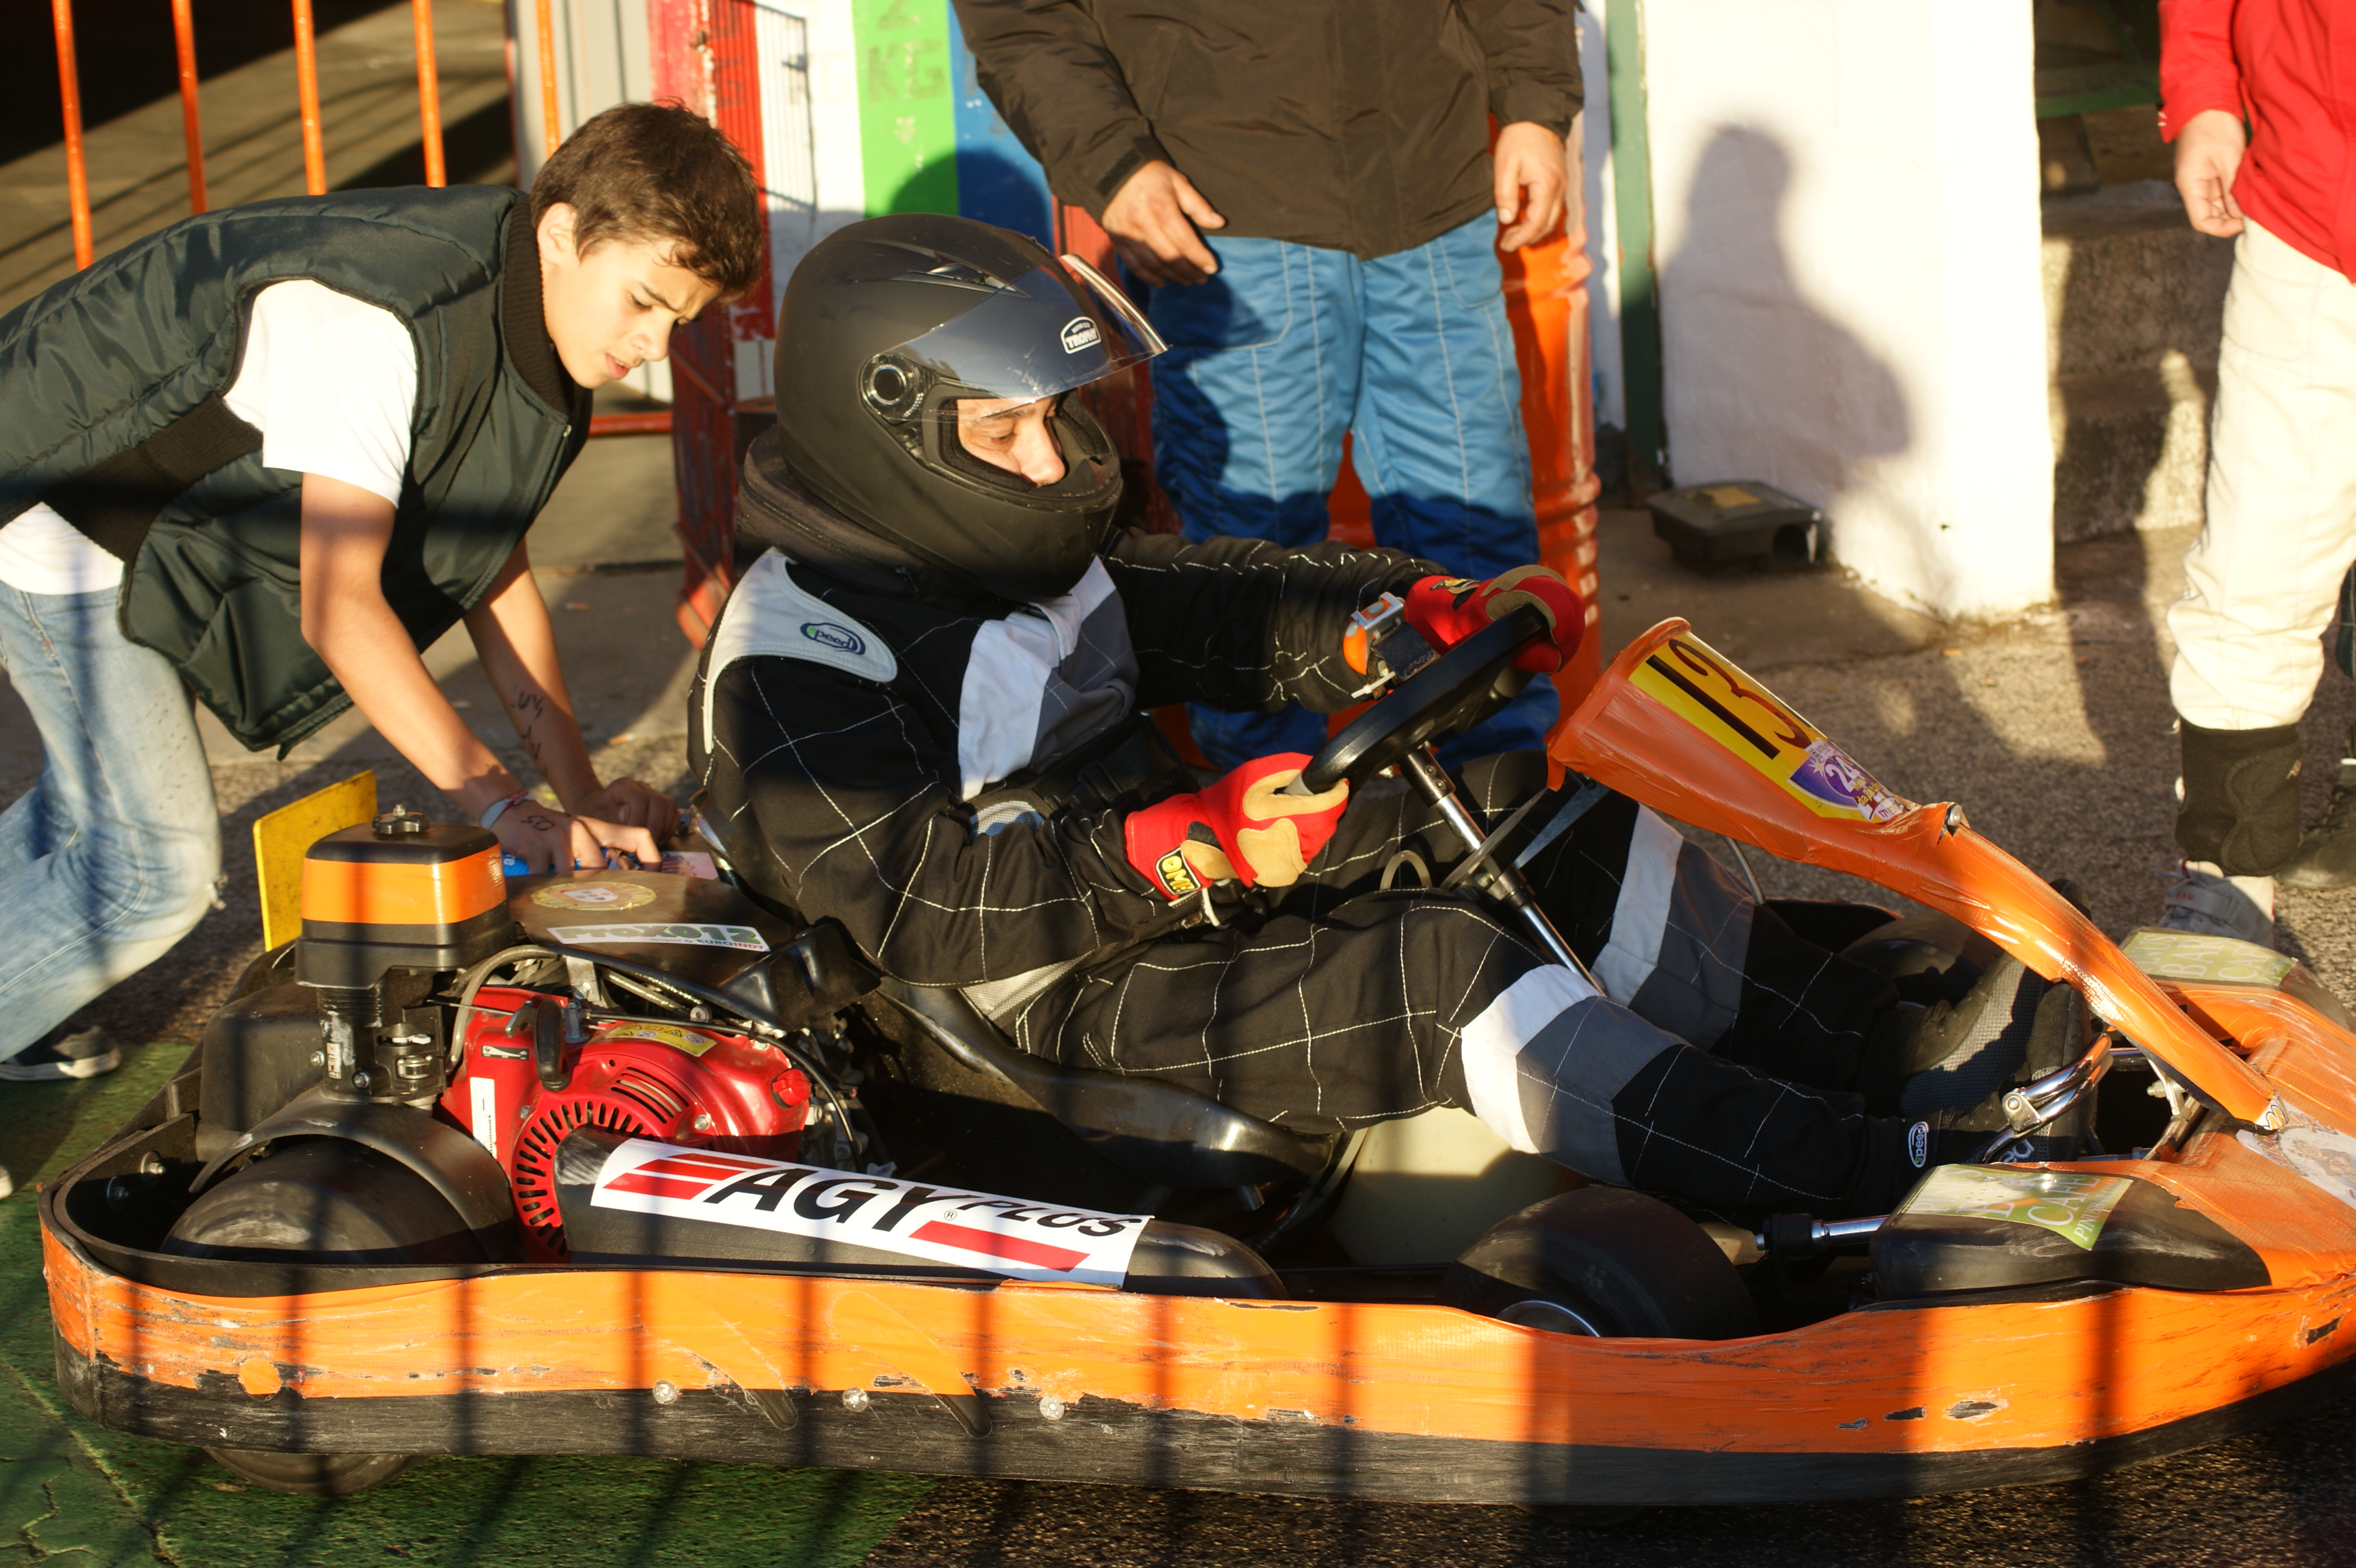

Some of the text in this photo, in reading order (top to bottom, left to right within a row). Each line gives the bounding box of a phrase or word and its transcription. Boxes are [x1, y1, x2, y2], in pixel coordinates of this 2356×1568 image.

[866, 41, 946, 104] KG
[1645, 639, 1812, 760] 13
[1824, 756, 1861, 793] 24
[2129, 935, 2177, 974] INUS
[2158, 939, 2229, 977] BAR
[1910, 1167, 1982, 1212] PINUS
[2027, 1177, 2101, 1225] CAFE
[956, 1194, 1149, 1237] PLUS
